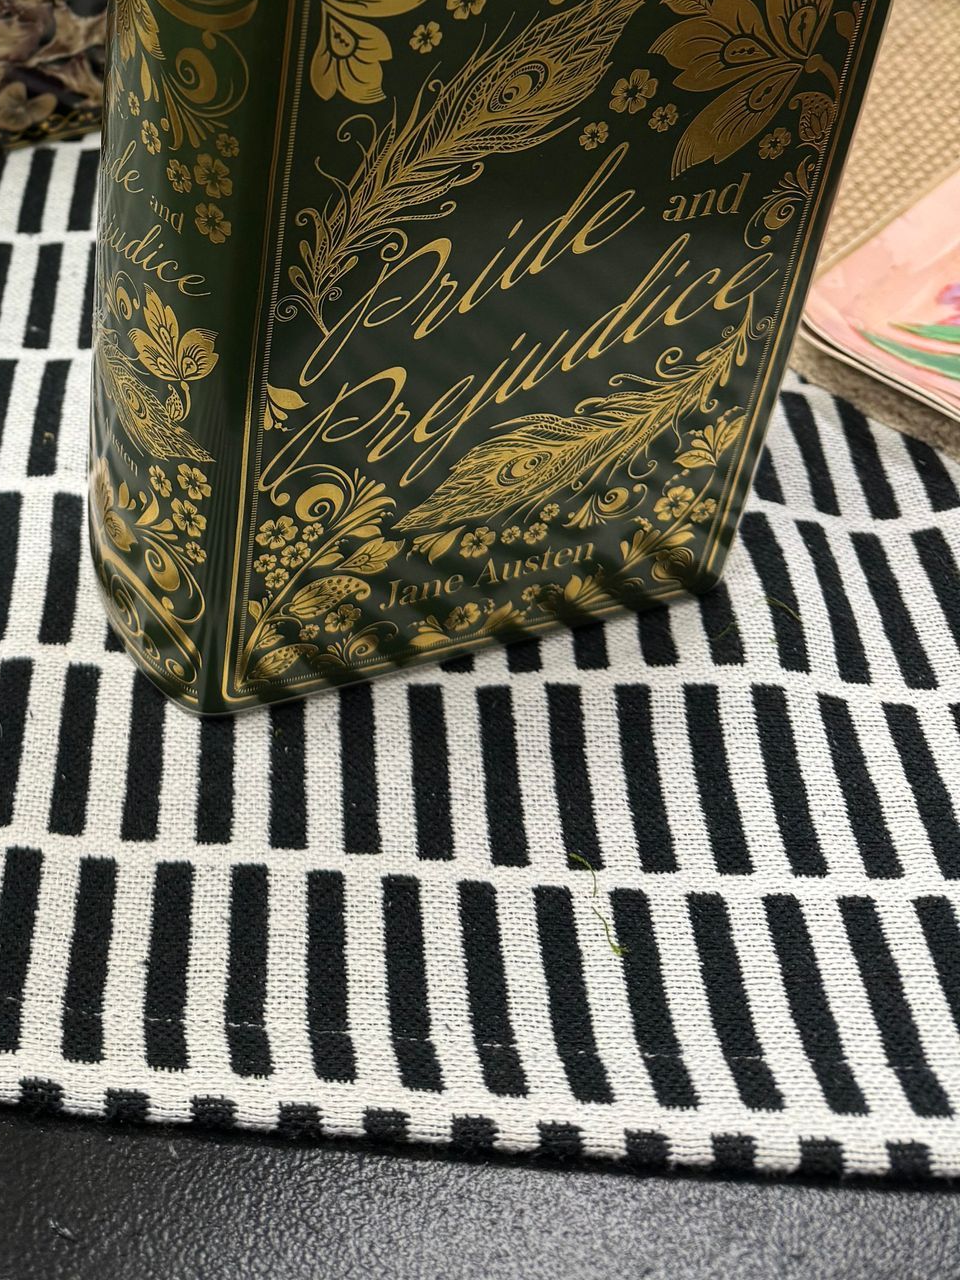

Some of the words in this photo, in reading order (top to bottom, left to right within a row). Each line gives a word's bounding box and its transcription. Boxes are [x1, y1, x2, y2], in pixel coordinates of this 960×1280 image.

[149, 194, 185, 234] and
[299, 141, 645, 387] Pride
[662, 173, 751, 222] and
[258, 232, 780, 492] Prejudice
[379, 572, 465, 610] Jane
[472, 541, 595, 589] Austen
